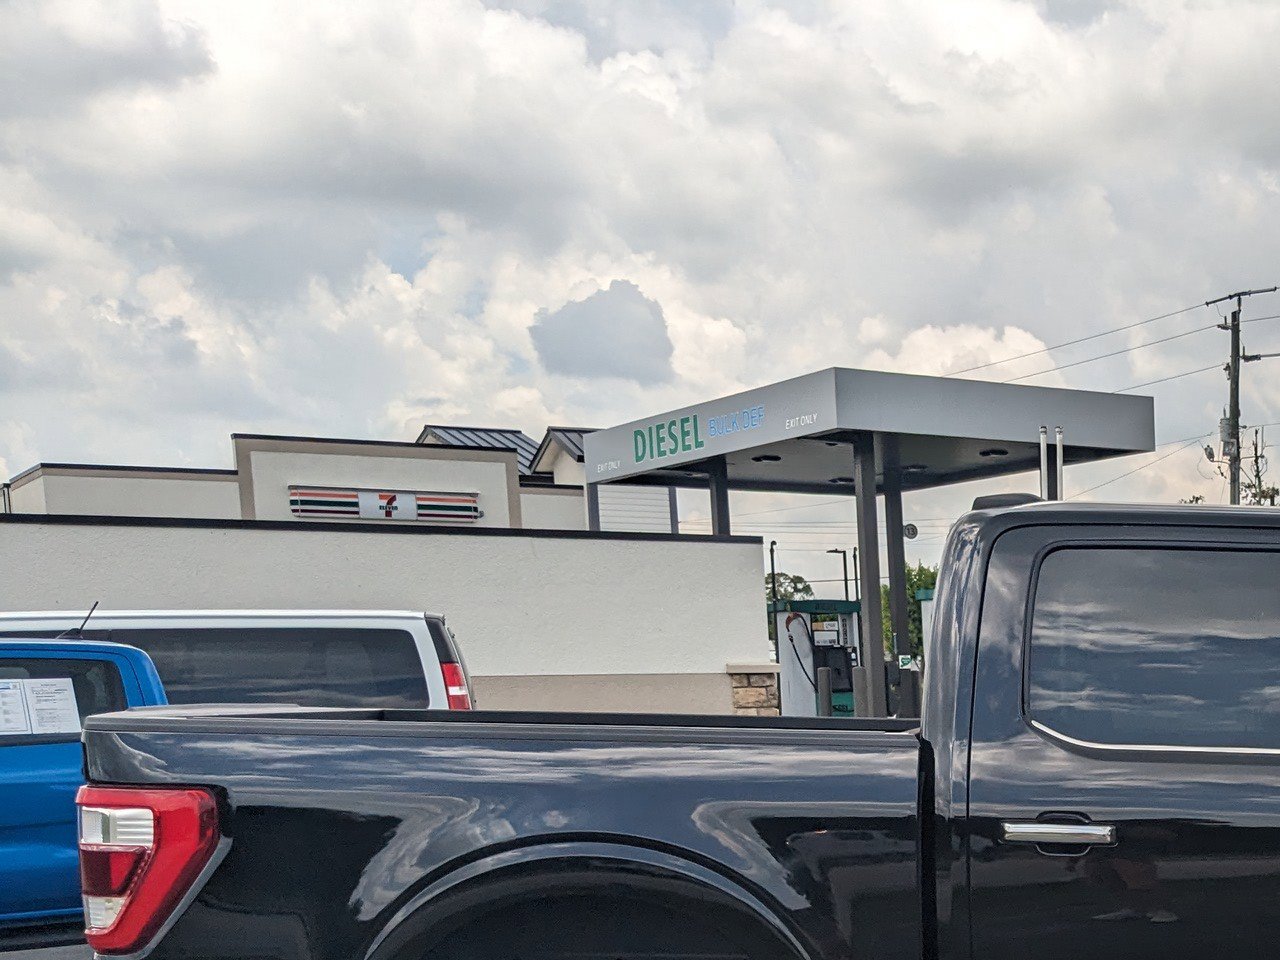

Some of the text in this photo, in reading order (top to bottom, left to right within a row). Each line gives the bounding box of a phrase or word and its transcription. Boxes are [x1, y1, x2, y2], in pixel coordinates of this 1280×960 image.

[708, 406, 764, 437] BULK DEF
[785, 413, 818, 430] EXIT ONLY
[633, 414, 704, 463] DIESEL
[378, 494, 397, 517] 7
